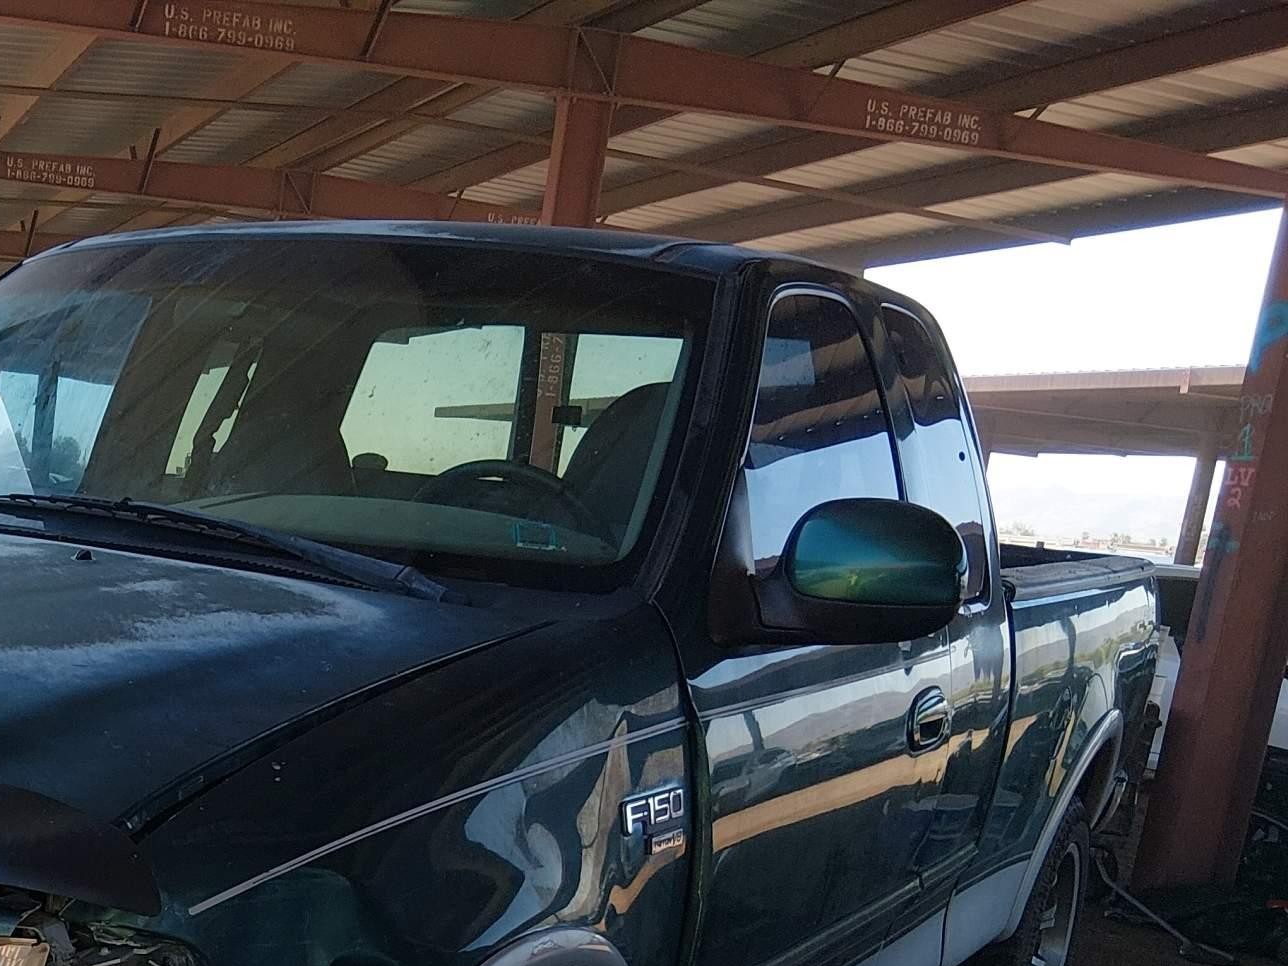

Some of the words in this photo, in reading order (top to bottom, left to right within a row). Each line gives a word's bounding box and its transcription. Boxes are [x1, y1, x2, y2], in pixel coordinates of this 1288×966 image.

[164, 3, 193, 22] U.S.
[202, 8, 262, 31] PREFAB
[268, 18, 297, 36] INC.
[865, 115, 980, 145] 1-866-799-0969
[866, 99, 892, 116] U.S.
[899, 104, 952, 125] PREFAB
[957, 114, 982, 130] INC.
